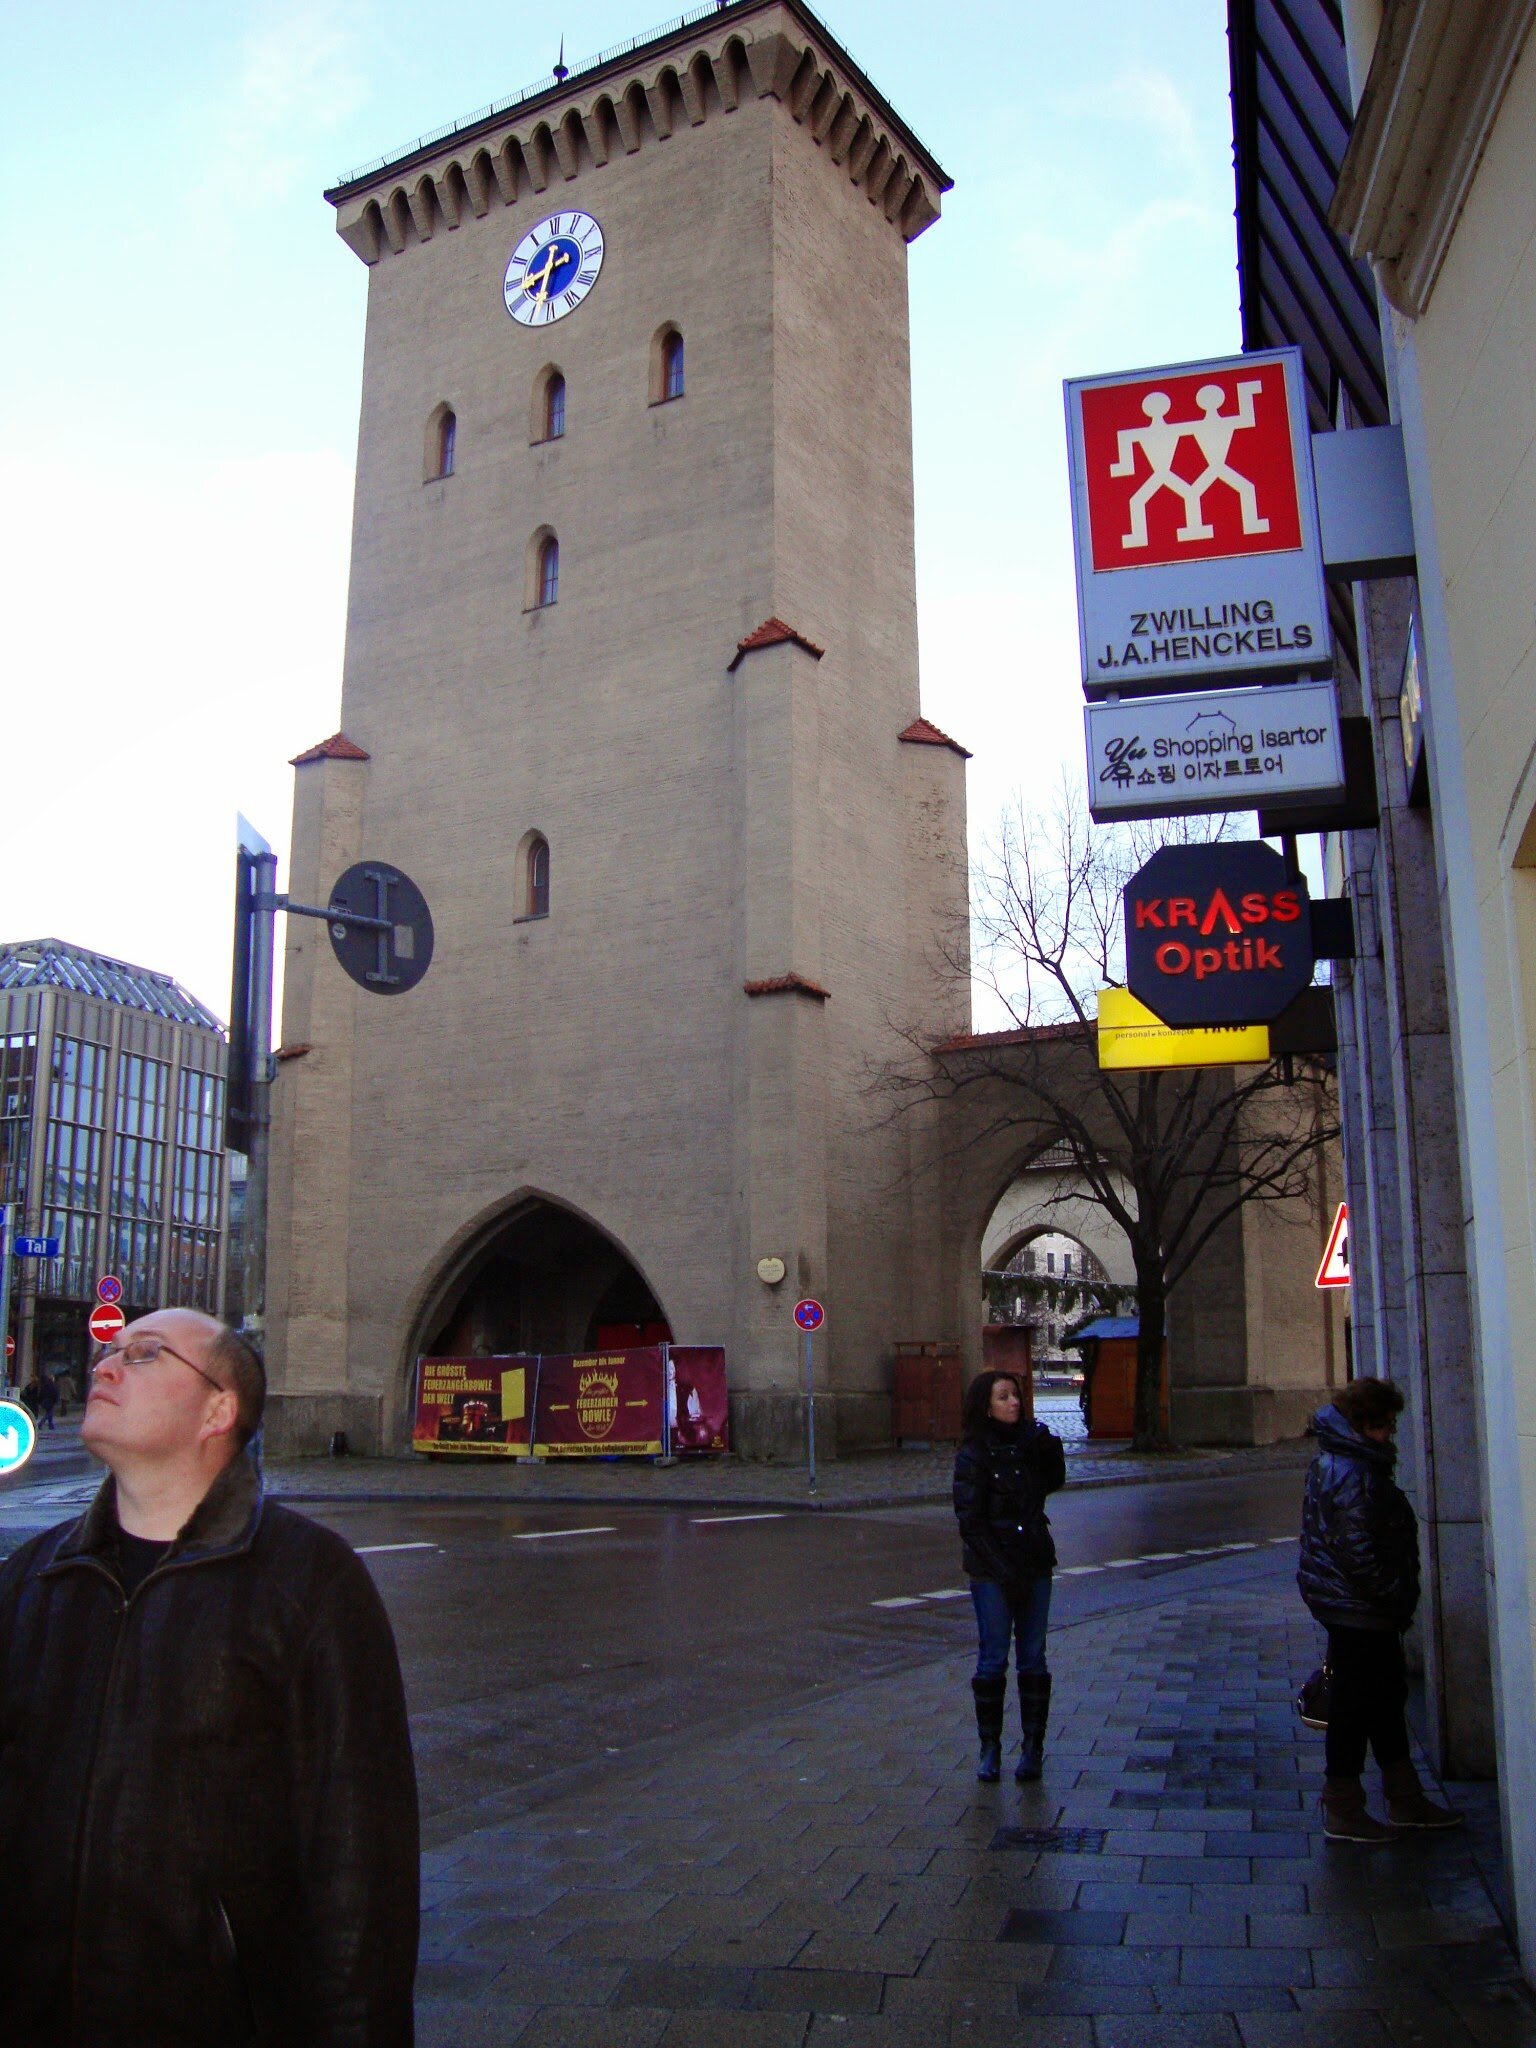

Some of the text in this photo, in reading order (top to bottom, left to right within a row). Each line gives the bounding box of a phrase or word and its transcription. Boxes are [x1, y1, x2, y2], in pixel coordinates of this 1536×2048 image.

[1130, 599, 1275, 637] ZWILLING
[1098, 624, 1313, 669] J.A.HENCKELS
[1153, 732, 1254, 759] Shopping
[1260, 727, 1327, 748] Isartor
[1135, 887, 1302, 936] KRASS
[1155, 937, 1285, 980] Optik
[26, 1239, 46, 1253] Tal
[424, 1364, 467, 1378] DIE GRÖSSTE
[423, 1378, 493, 1392] FEUERZANGENBOWLE
[422, 1393, 455, 1405] DER WELT
[576, 1396, 619, 1410] FEUERZANGEN
[582, 1409, 612, 1424] BOWLE
